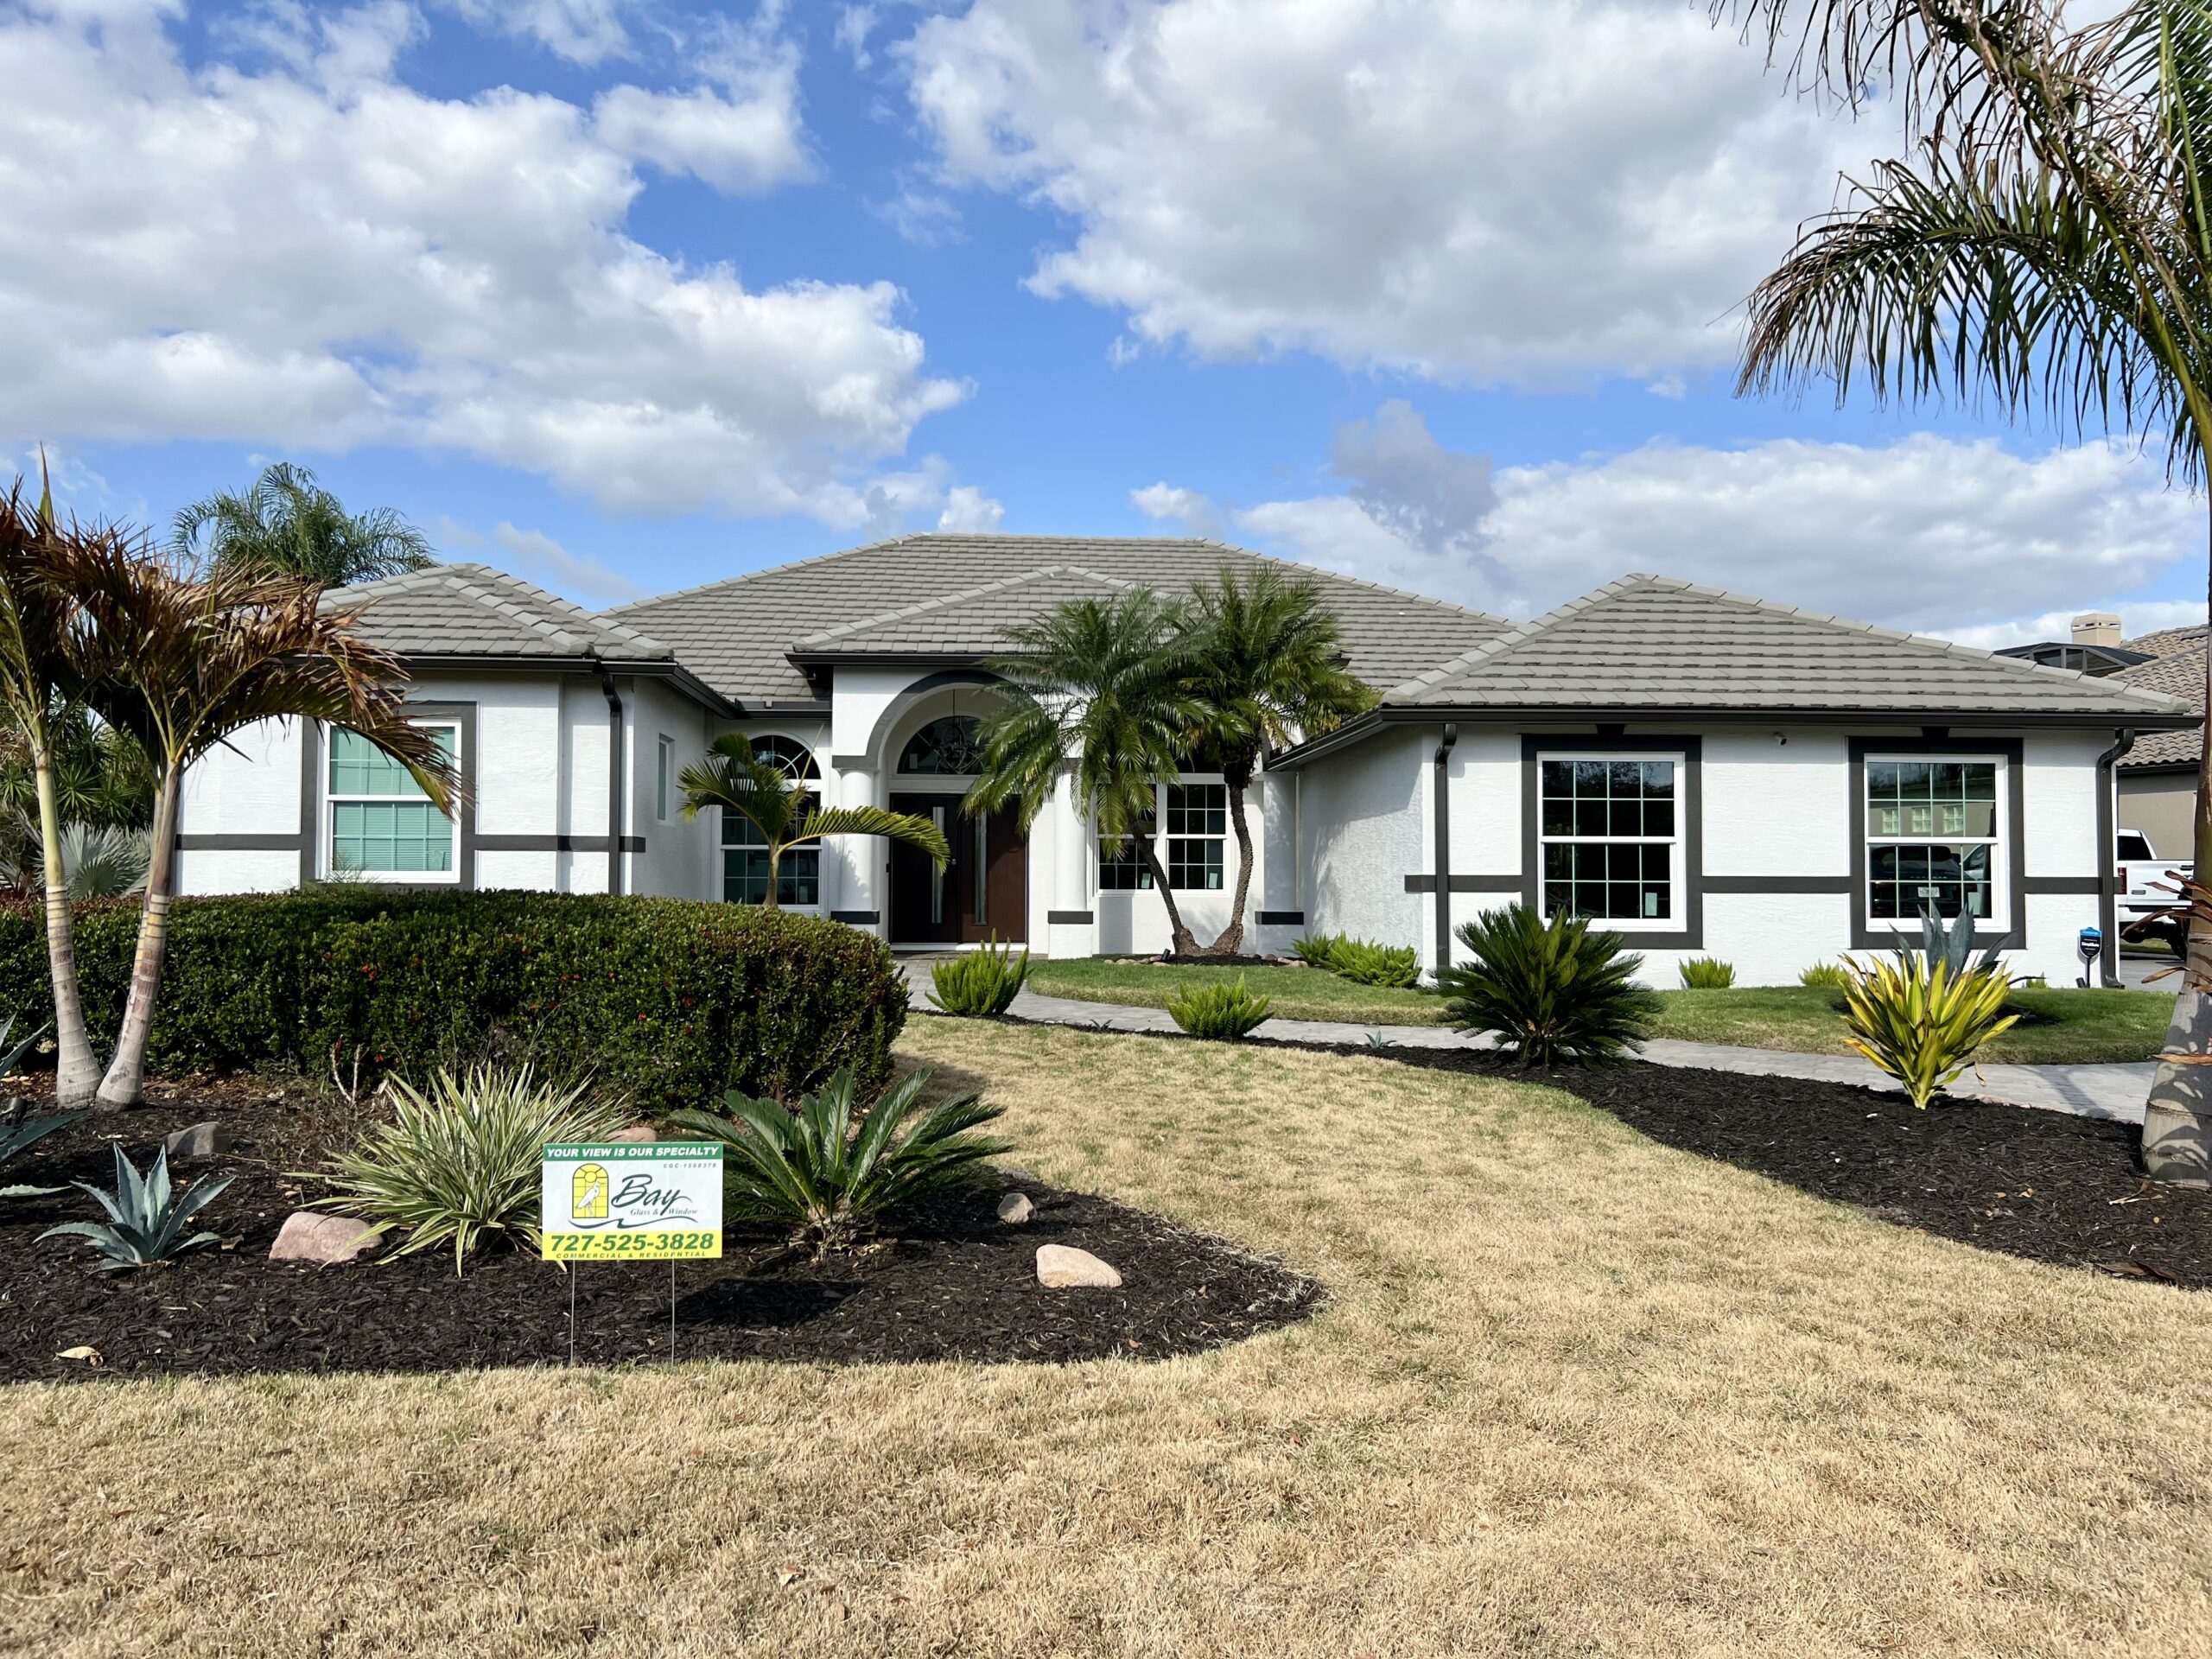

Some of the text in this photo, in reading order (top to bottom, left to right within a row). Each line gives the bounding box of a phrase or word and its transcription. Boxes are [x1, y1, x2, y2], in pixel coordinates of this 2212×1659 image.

[547, 1147, 719, 1157] YOUR VIEW IS OUR SPECIALTY
[611, 1174, 692, 1216] Bay
[550, 1234, 714, 1251] 727-525-3828
